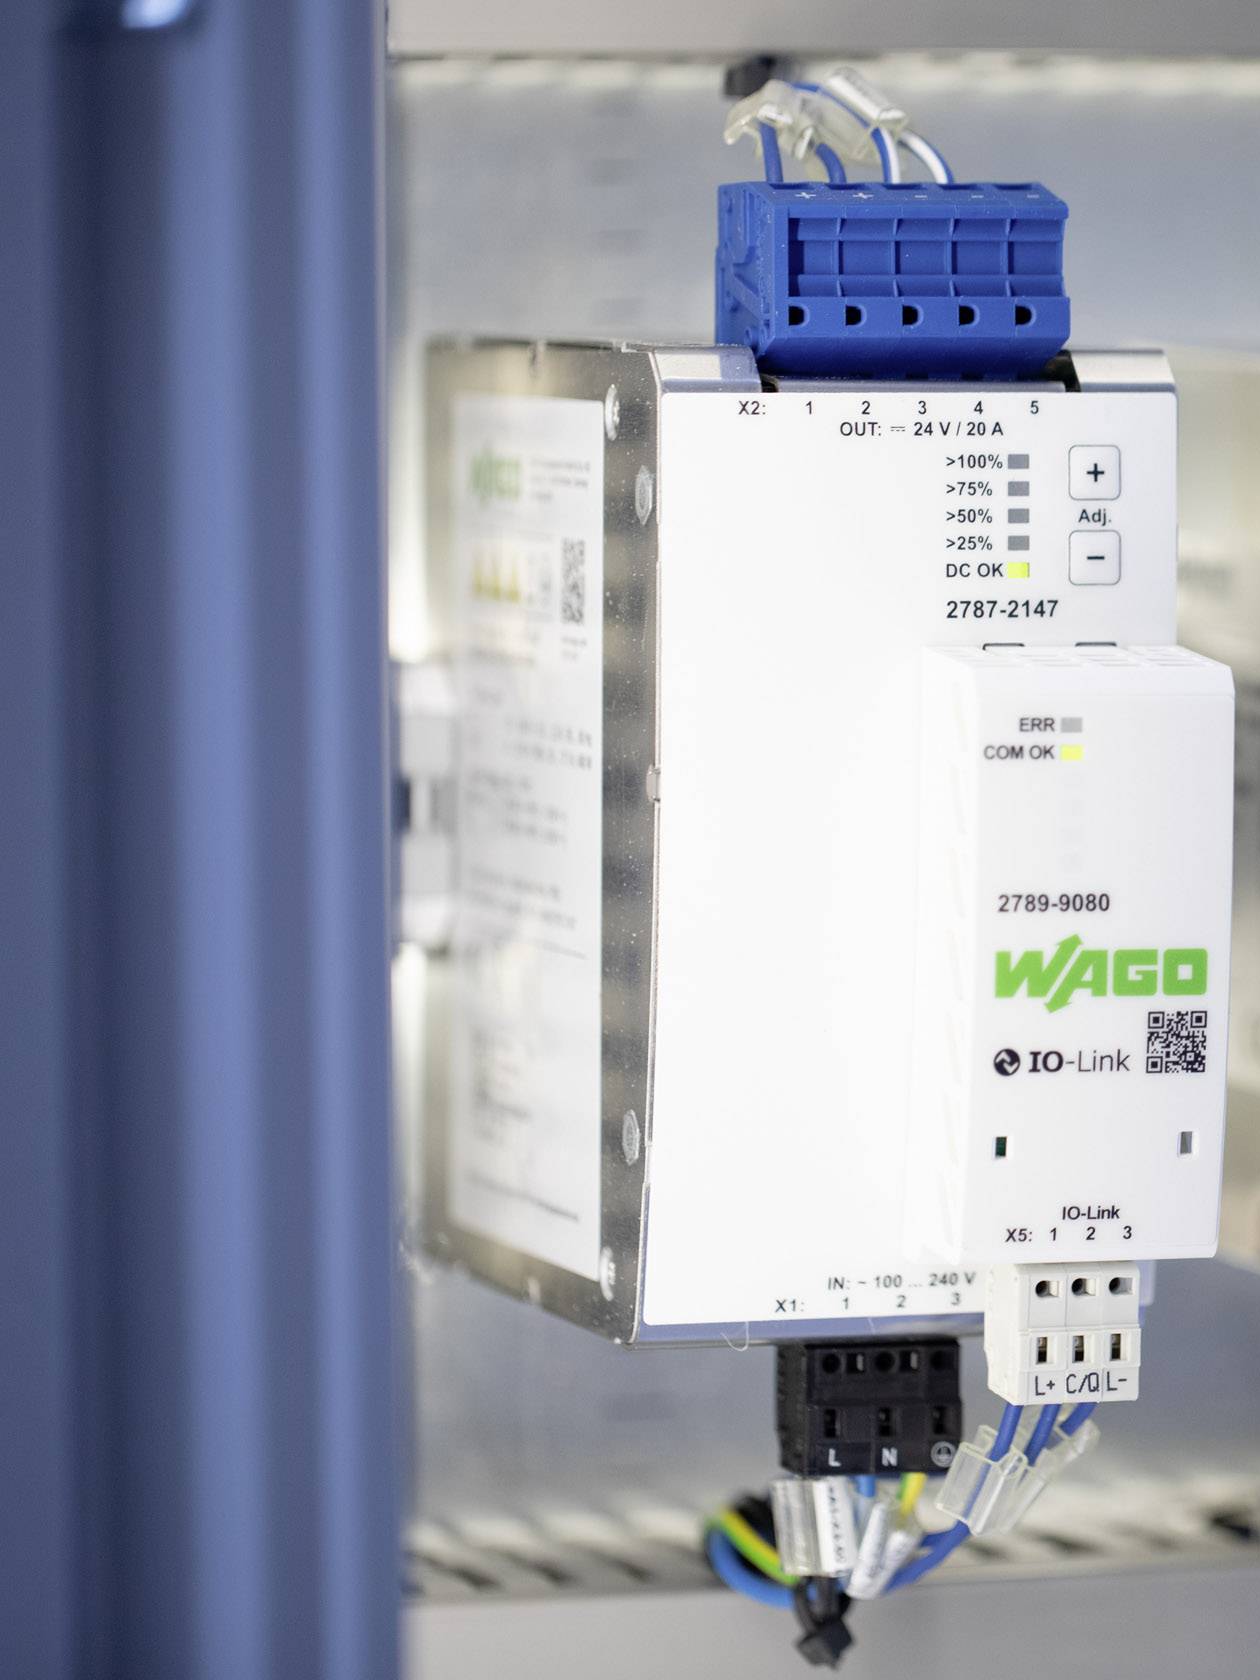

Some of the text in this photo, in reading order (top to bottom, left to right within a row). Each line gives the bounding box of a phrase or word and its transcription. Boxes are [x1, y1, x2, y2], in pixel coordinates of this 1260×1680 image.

[738, 400, 1040, 416] X2: 1 2 3 4 5
[839, 421, 882, 437] OUT:
[913, 421, 934, 437] 24
[939, 421, 951, 436] V
[966, 421, 987, 437] 20
[991, 421, 1004, 436] A
[946, 454, 1003, 469] >100%
[946, 481, 993, 497] >75%
[946, 508, 993, 524] >50%
[1078, 508, 1112, 527] Adj.
[946, 535, 993, 551] >25%
[945, 562, 1004, 578] DC OK
[946, 599, 1059, 619] 2787-2147
[1019, 716, 1056, 733] ERR
[983, 744, 1055, 760] COM OK
[998, 892, 1111, 913] 2789-9080
[995, 934, 1208, 1013] WAGO
[1028, 1048, 1131, 1073] IO-Link
[1062, 1204, 1121, 1221] IO-Link
[1005, 1225, 1133, 1243] X5: 1 2 3
[828, 1276, 850, 1290] IN:
[875, 1274, 903, 1289] 100
[929, 1272, 959, 1287] 240
[964, 1271, 976, 1285] V
[775, 1291, 962, 1313] X1: 1 2 3
[1034, 1370, 1128, 1397] L+ C/Q L-
[828, 1447, 899, 1468] L N
